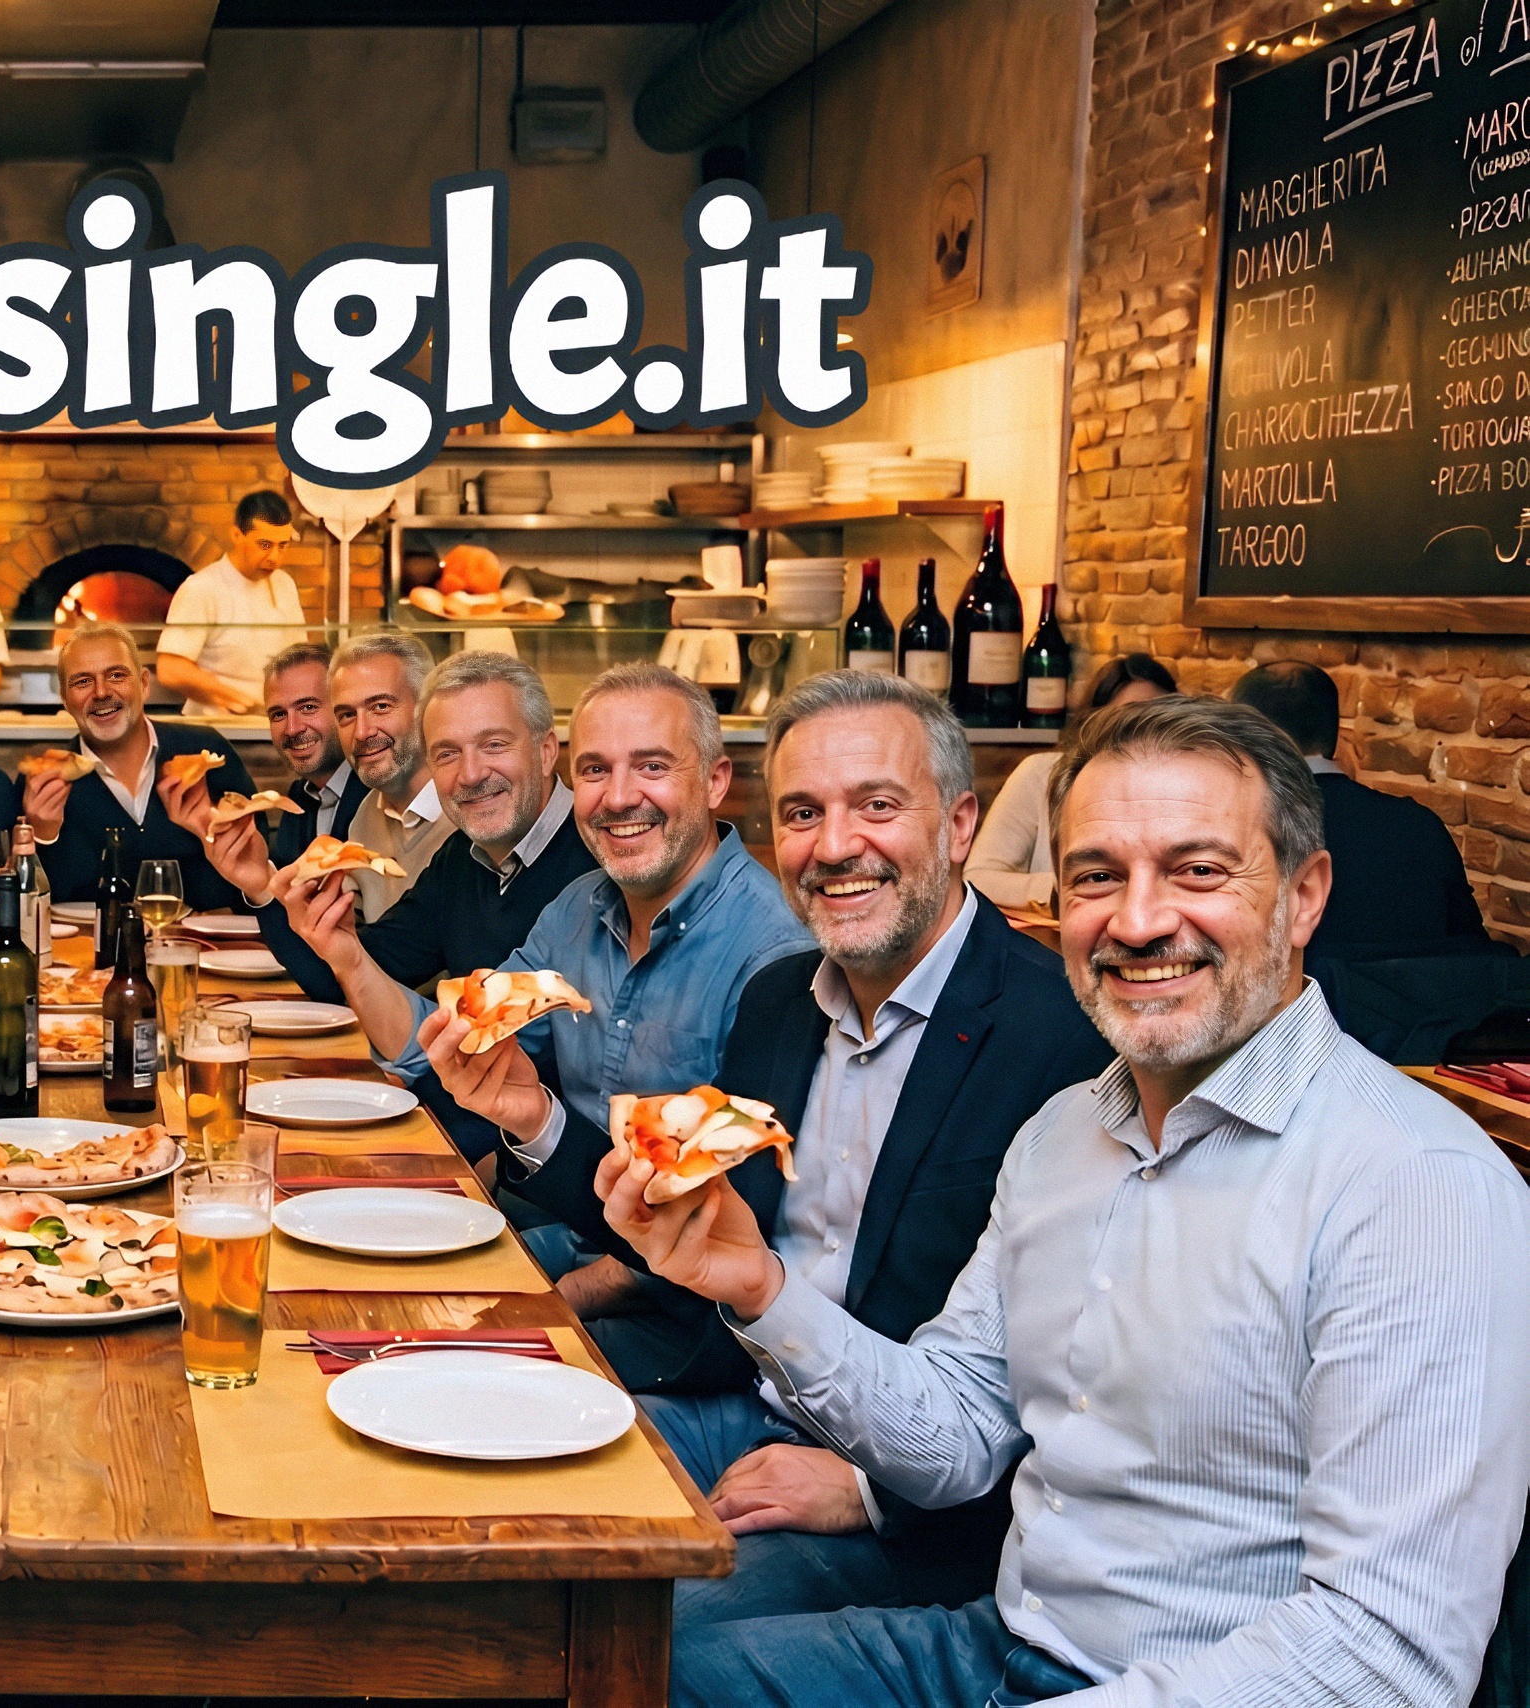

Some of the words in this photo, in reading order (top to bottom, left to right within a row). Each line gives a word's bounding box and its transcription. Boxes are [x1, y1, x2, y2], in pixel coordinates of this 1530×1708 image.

[1325, 17, 1440, 121] PIZZA
[1238, 144, 1387, 232] MARGHERITA
[1235, 221, 1334, 290] DIAVOLA
[1221, 459, 1337, 511] MARTOLLA
[1437, 462, 1492, 496] PIZZA
